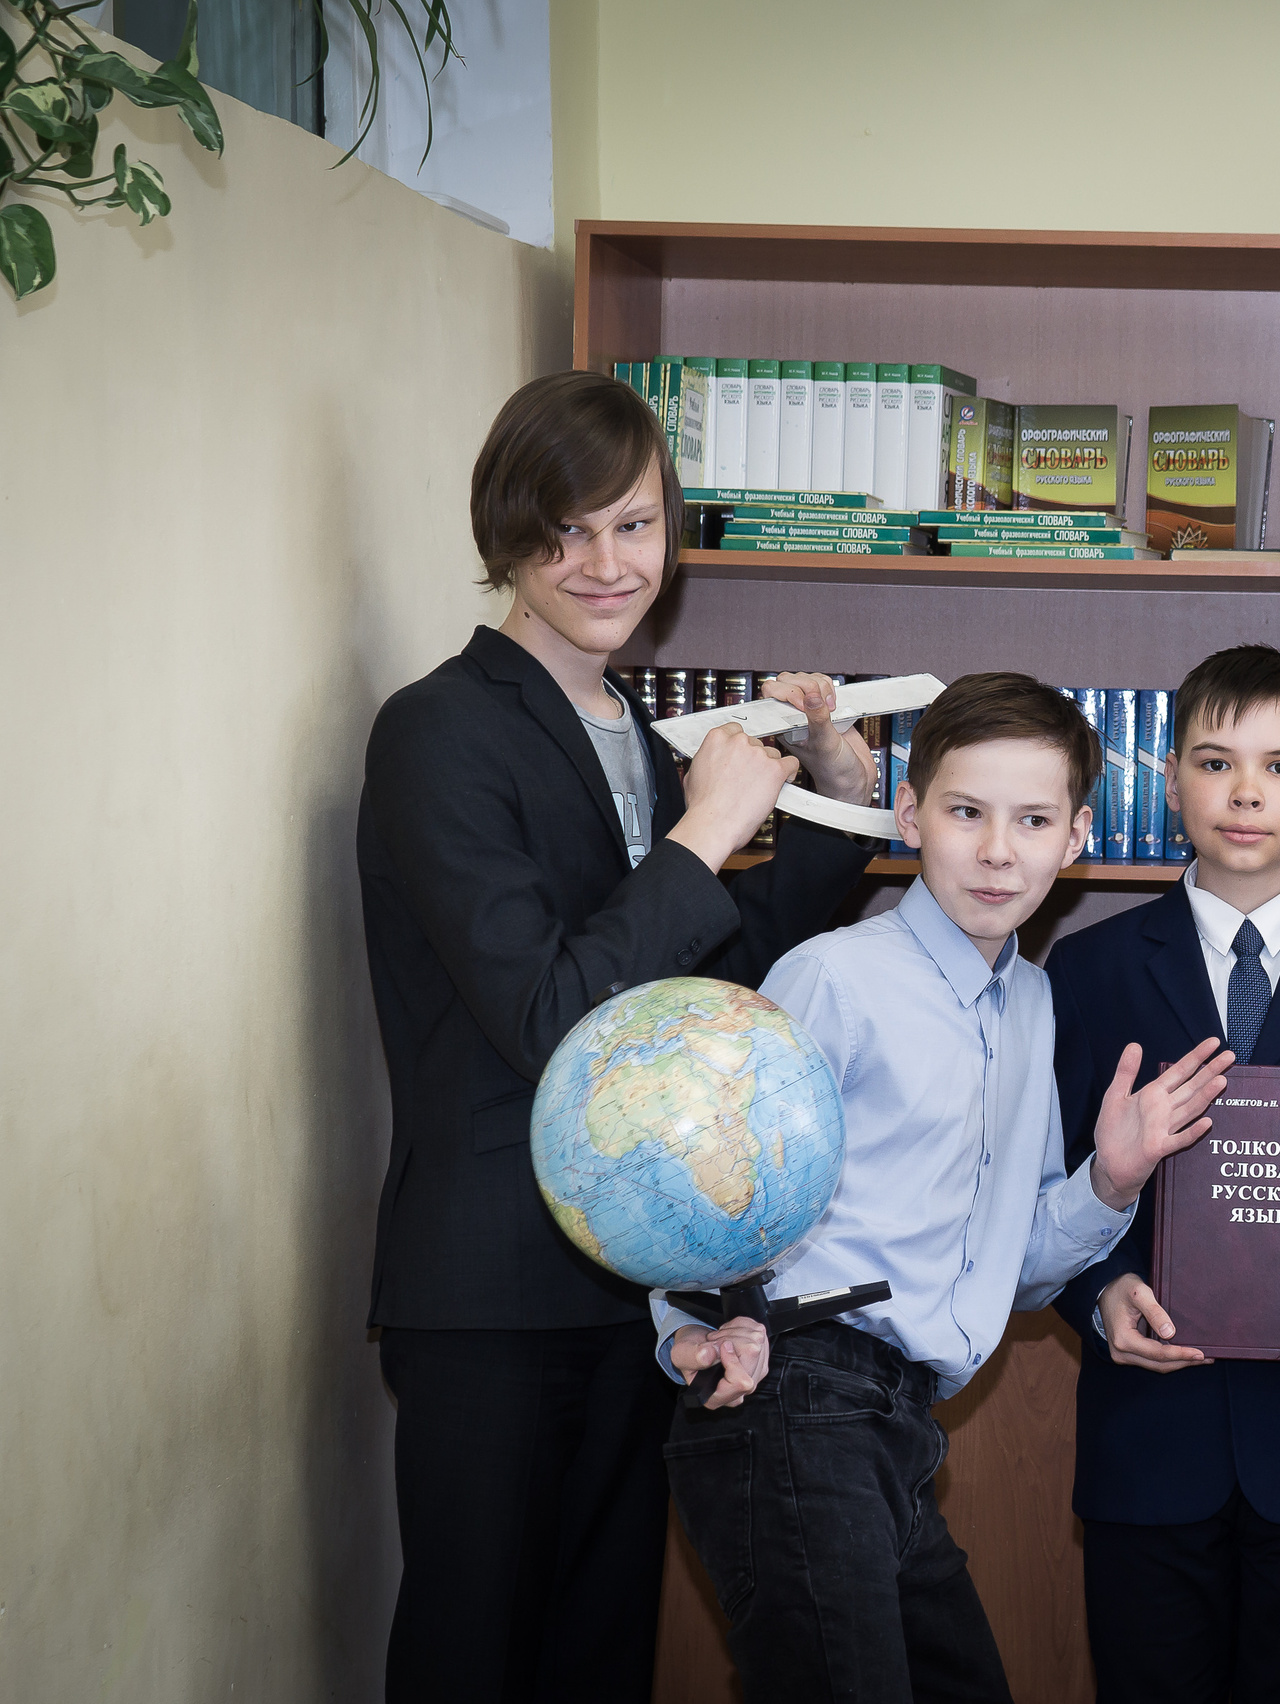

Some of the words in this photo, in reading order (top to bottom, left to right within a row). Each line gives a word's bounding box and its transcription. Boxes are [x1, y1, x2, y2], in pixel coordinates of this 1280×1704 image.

[667, 396, 678, 432] СЛОВАРЬ
[1021, 429, 1108, 442] ОРФОГРАФИЧЕСКИЙ
[1153, 430, 1230, 444] ОРФОГРАФИЧЕСКИЙ
[957, 429, 966, 463] СЛОВАРЬ
[968, 451, 977, 480] ЯЗЫКА
[1021, 447, 1108, 470] СЛОВАРЬ
[1153, 449, 1229, 471] СЛОВАРЬ
[1036, 475, 1069, 485] РУССКОГО
[1070, 475, 1092, 485] ЯЗЫКА
[1165, 477, 1194, 487] РУССКОГО
[1195, 477, 1215, 486] ЯЗЫКА
[955, 465, 964, 510] АФИЧЕСКИЙ
[717, 490, 741, 499] Учебный
[744, 493, 795, 501] фразеологический
[799, 493, 834, 505] СЛОВАРЬ
[770, 509, 795, 518] Учебный
[798, 511, 848, 521] фразеологический
[852, 512, 887, 524] СЛОВАРЬ
[956, 514, 980, 522] Учебный
[984, 514, 1034, 524] фразеологический
[1038, 515, 1073, 526] СЛОВАРЬ
[761, 525, 786, 534] Учебный
[789, 527, 839, 536] фразеологический
[842, 528, 878, 539] СЛОВАРЬ
[974, 529, 998, 538] Учебный
[1001, 530, 1051, 540] фразеологический
[1054, 530, 1089, 541] СЛОВАРЬ
[756, 541, 780, 550] Учебный
[784, 543, 833, 552] фразеологический
[836, 543, 871, 554] СЛОВАРЬ
[988, 547, 1012, 556] Учебный
[1016, 548, 1065, 558] фразеологический
[1069, 548, 1104, 558] СЛОВАРЬ
[1226, 1099, 1262, 1107] ОЖЕГОВ
